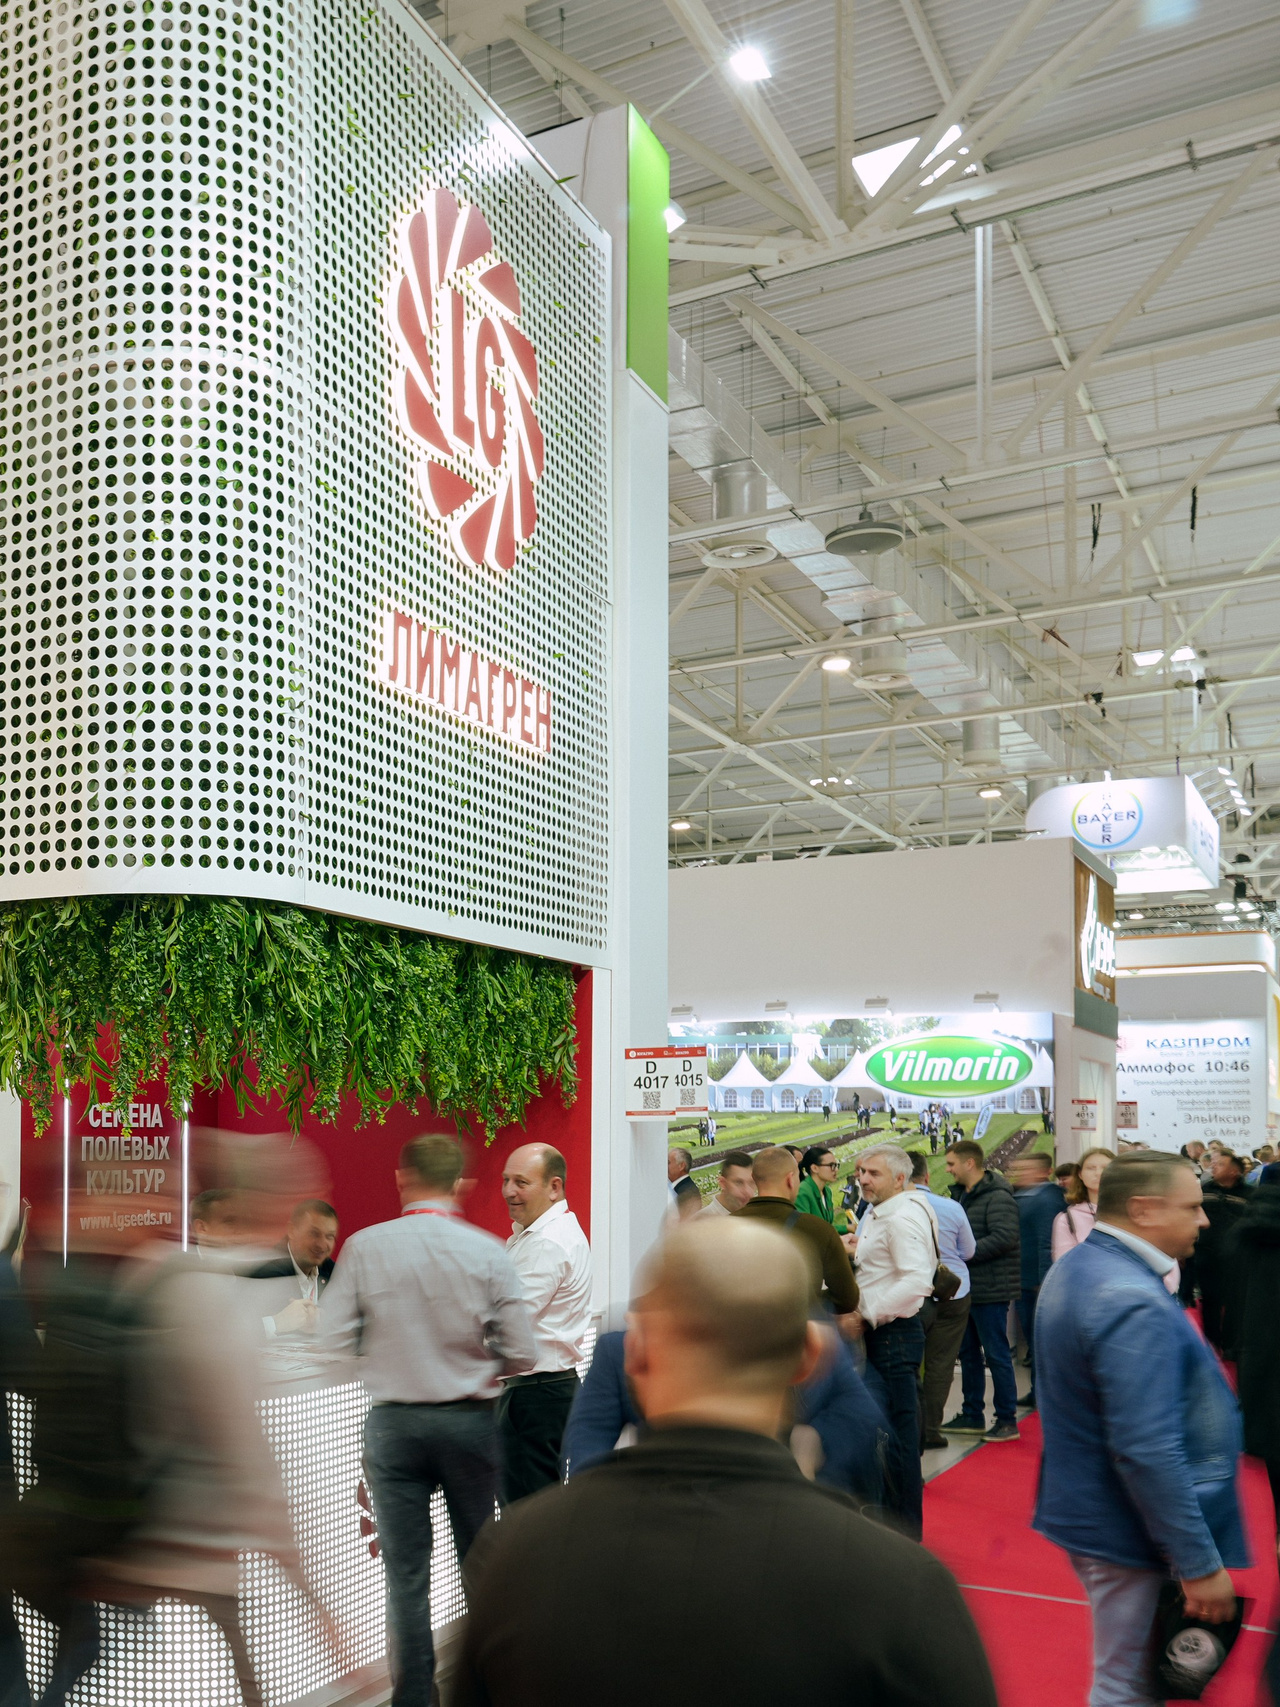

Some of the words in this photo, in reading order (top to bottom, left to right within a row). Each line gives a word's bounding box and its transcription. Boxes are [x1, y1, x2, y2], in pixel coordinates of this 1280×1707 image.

[448, 287, 506, 469] LG
[388, 609, 552, 754] ЛИМАГРЕН
[1077, 811, 1137, 824] BAYER
[1146, 1037, 1251, 1049] КАЗПРОМ
[646, 1061, 656, 1073] D
[683, 1060, 692, 1072] D
[882, 1049, 1020, 1081] Vilmorin
[1116, 1062, 1195, 1075] Аммофос
[1206, 1060, 1250, 1072] 10:46
[634, 1076, 669, 1089] 4017
[675, 1074, 703, 1087] 4015
[1183, 1113, 1251, 1125] ЭльИксир
[81, 1136, 170, 1162] ПОЛЕВЫХ
[86, 1168, 166, 1196] КУЛЬТУР
[80, 1209, 172, 1232] www.lgseeds.ru
